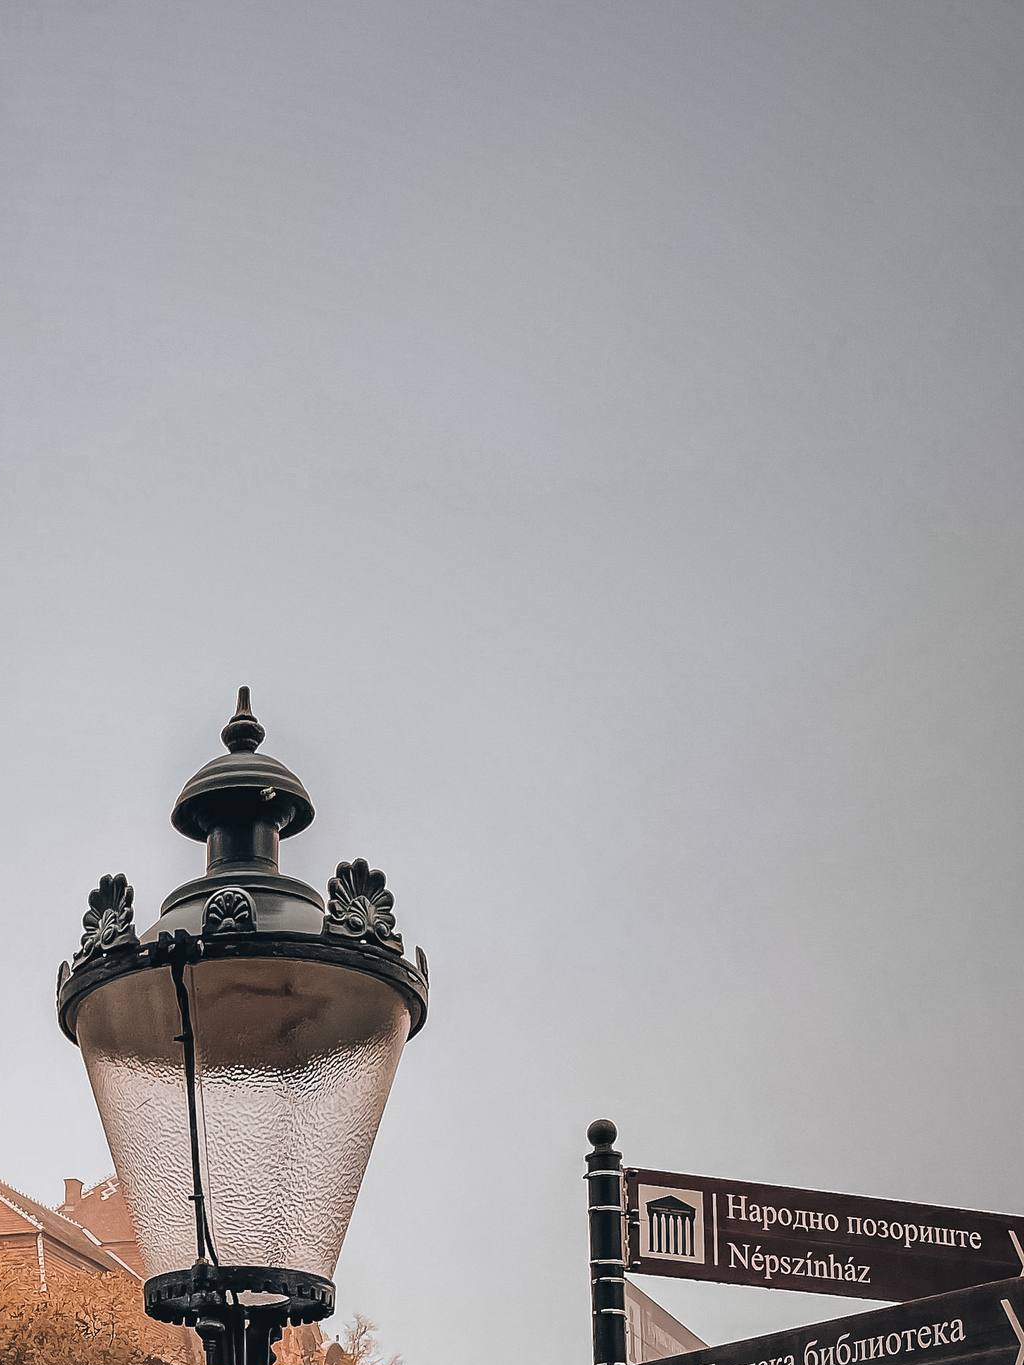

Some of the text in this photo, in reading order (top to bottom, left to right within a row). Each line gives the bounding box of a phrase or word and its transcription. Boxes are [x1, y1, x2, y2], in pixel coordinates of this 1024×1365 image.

[726, 1193, 982, 1250] Народно позориште
[726, 1242, 871, 1284] Népszínház
